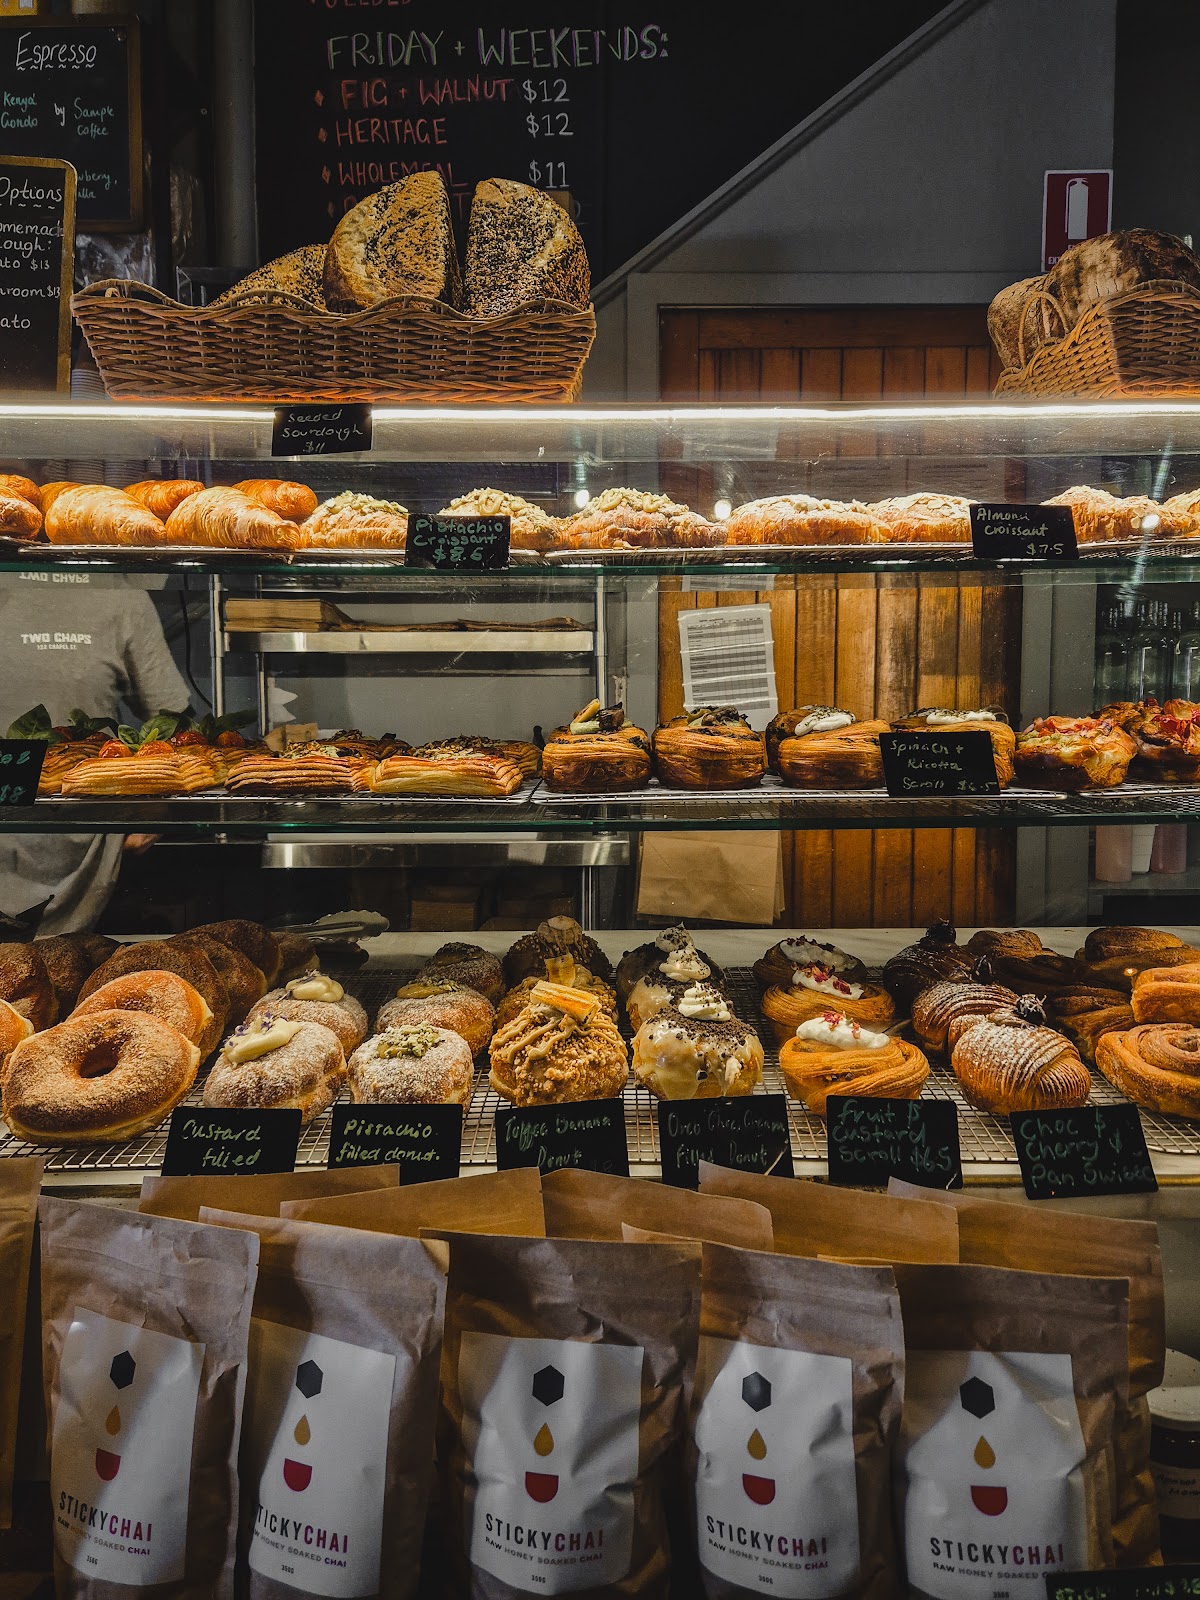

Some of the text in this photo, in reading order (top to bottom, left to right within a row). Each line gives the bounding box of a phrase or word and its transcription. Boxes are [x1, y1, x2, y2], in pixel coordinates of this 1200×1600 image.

[16, 31, 97, 70] Espresso
[327, 30, 444, 69] FRIDAY
[454, 40, 466, 56] +
[341, 77, 388, 109] FIG
[419, 74, 514, 106] WALNUT
[522, 79, 569, 103] $12
[54, 103, 65, 126] by
[335, 112, 574, 146] HERITAGE $12
[529, 159, 569, 188] $11
[30, 258, 50, 272] $13
[20, 632, 92, 645] TWO CHAPS
[890, 736, 949, 756] Spinach
[907, 757, 963, 771] Ricotta
[182, 1119, 261, 1141] Custard
[556, 1114, 611, 1135] Banana
[668, 1112, 701, 1137] Oreo
[127, 1546, 150, 1556] CHAI
[485, 1536, 502, 1550] RAW
[504, 1547, 534, 1561] HONEY
[708, 1538, 726, 1551] RAW
[804, 1561, 829, 1571] CHAI
[324, 1557, 347, 1568] CHAI
[933, 1562, 955, 1573] RAW
